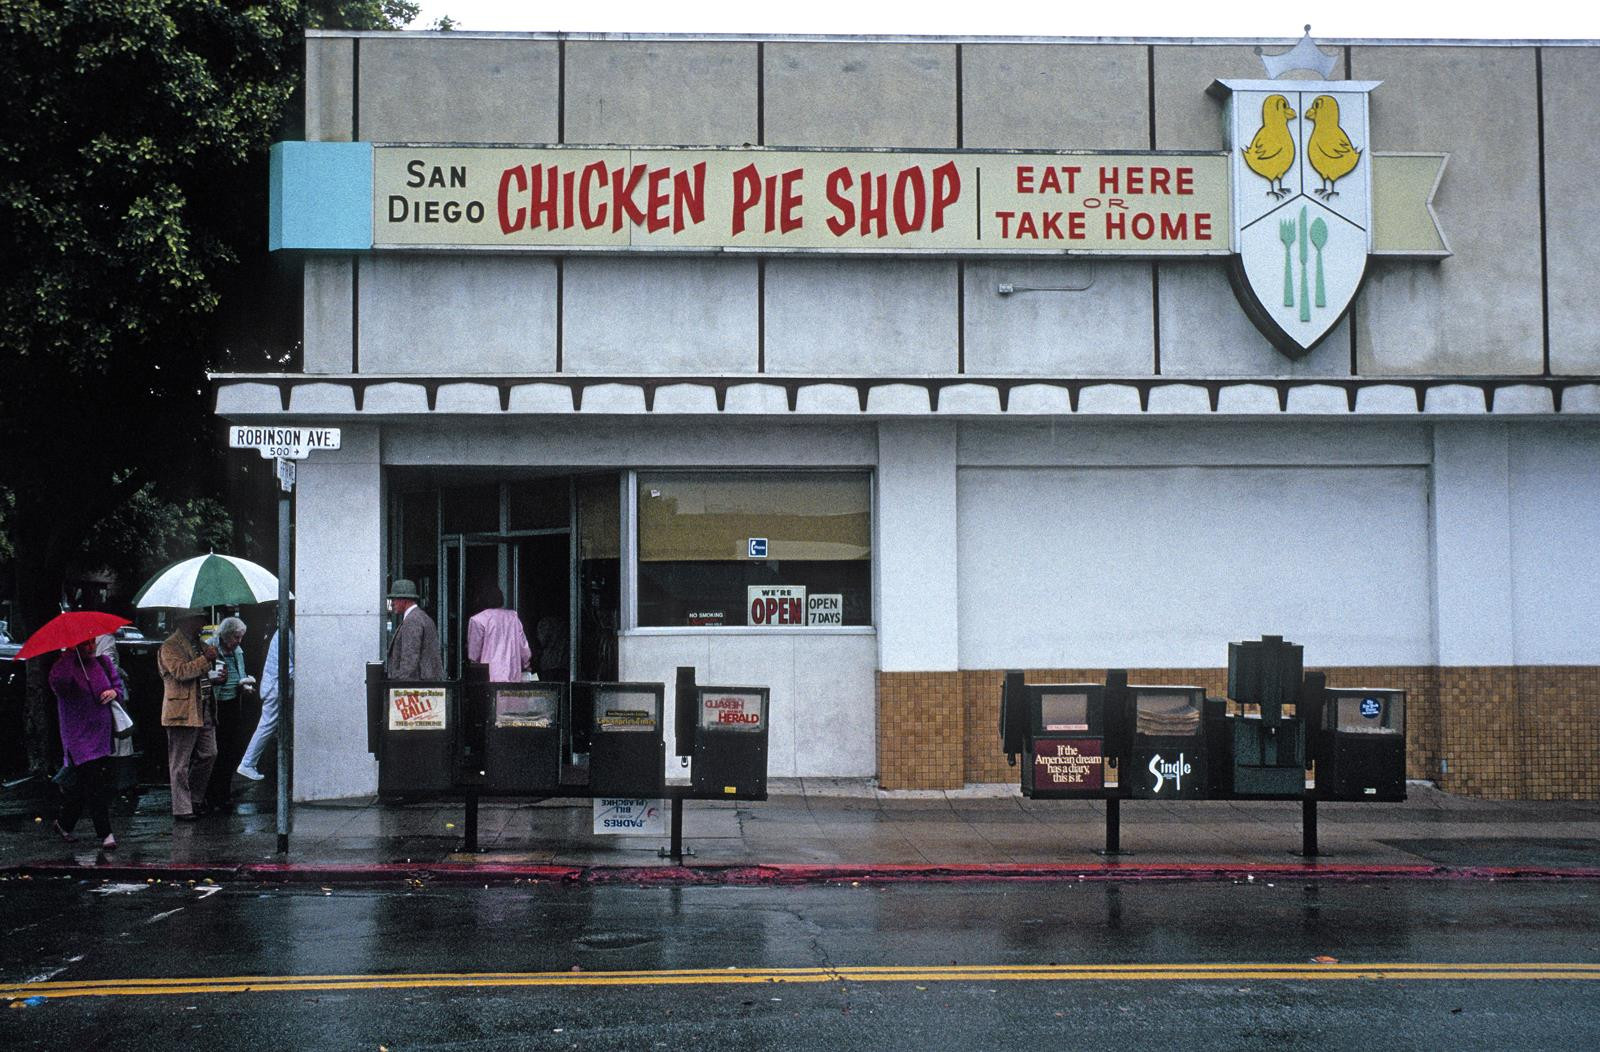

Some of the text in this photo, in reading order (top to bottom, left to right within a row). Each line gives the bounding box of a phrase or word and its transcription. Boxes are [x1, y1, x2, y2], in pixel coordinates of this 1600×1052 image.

[406, 159, 467, 188] SAN
[1016, 166, 1194, 195] EAT HERE
[497, 160, 961, 237] CHICKEN PIE SHOP
[1082, 197, 1129, 210] OR
[388, 194, 486, 224] DIEGO
[995, 211, 1212, 241] TAKE HOME
[237, 429, 336, 447] ROBINSON AVE.
[270, 447, 290, 456] 500
[809, 598, 838, 609] OPEN
[751, 598, 802, 625] OPEN
[811, 612, 841, 624] 7 DAYS
[395, 694, 419, 710] PLAY
[400, 699, 433, 720] BALL!
[718, 712, 759, 723] HERALD
[1057, 745, 1078, 757] If the
[1034, 754, 1102, 764] American dream
[1047, 763, 1062, 774] has
[1068, 763, 1090, 775] diary,
[1053, 773, 1084, 783] this is it.
[603, 819, 643, 828] PADRES
